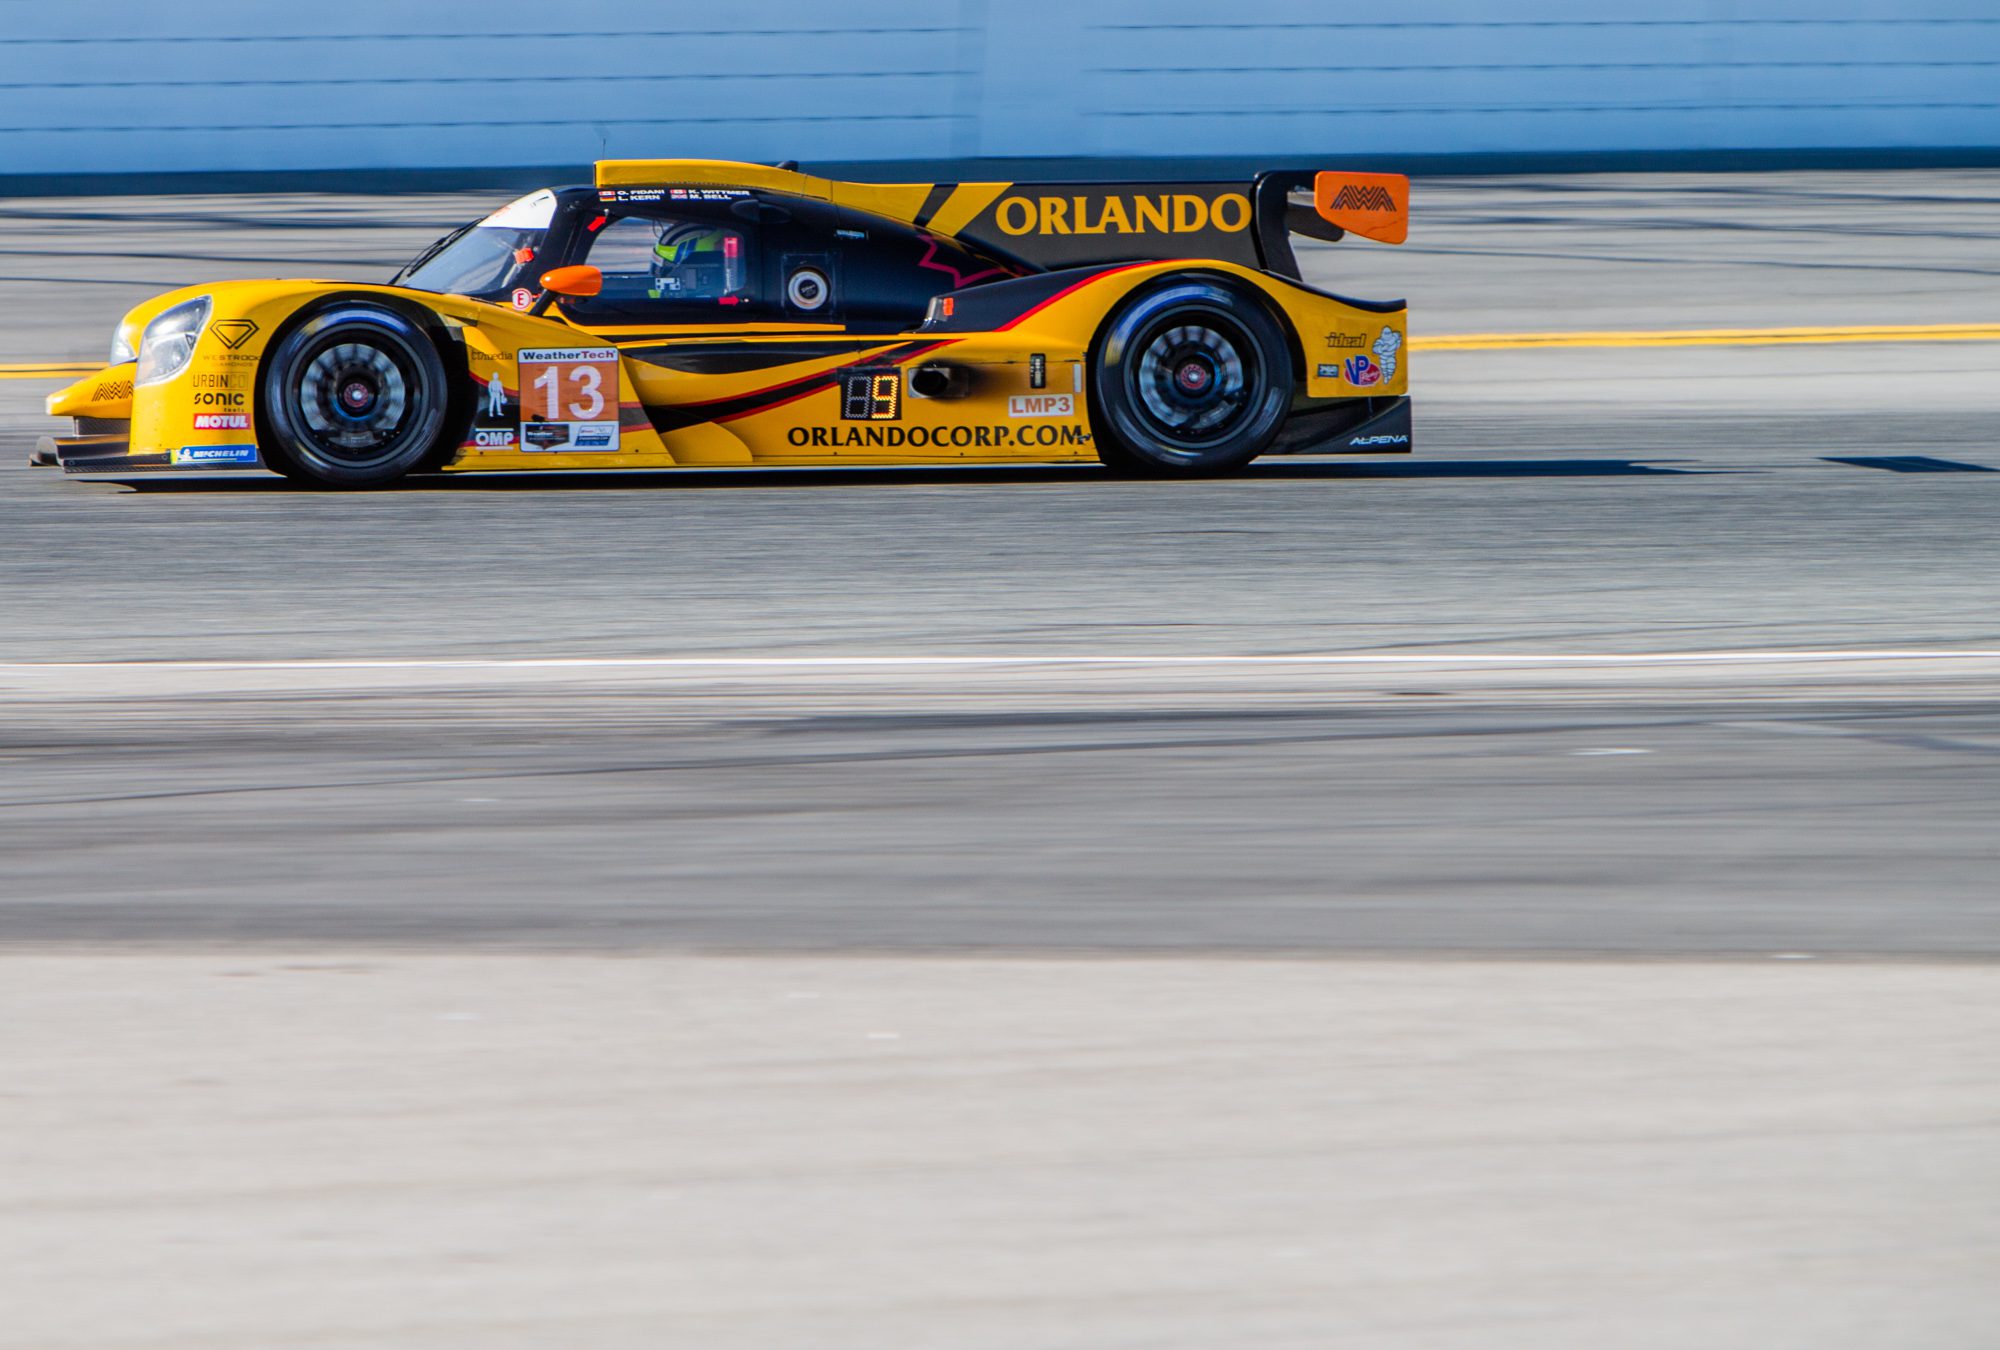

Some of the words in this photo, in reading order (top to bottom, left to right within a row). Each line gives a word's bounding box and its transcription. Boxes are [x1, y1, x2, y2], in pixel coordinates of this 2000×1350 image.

[995, 193, 1253, 236] ORLANDO
[517, 294, 525, 306] E
[1326, 332, 1367, 348] ideal
[523, 350, 615, 360] WeatherTech
[1345, 355, 1370, 385] VP
[534, 365, 605, 420] 13
[1012, 397, 1071, 414] LMP3
[195, 415, 248, 428] MOTUL
[475, 432, 514, 446] OMP
[787, 424, 1083, 447] ORLANDOCORP.COM
[1350, 435, 1408, 445] ALPENA
[193, 449, 249, 458] MICHELIN
